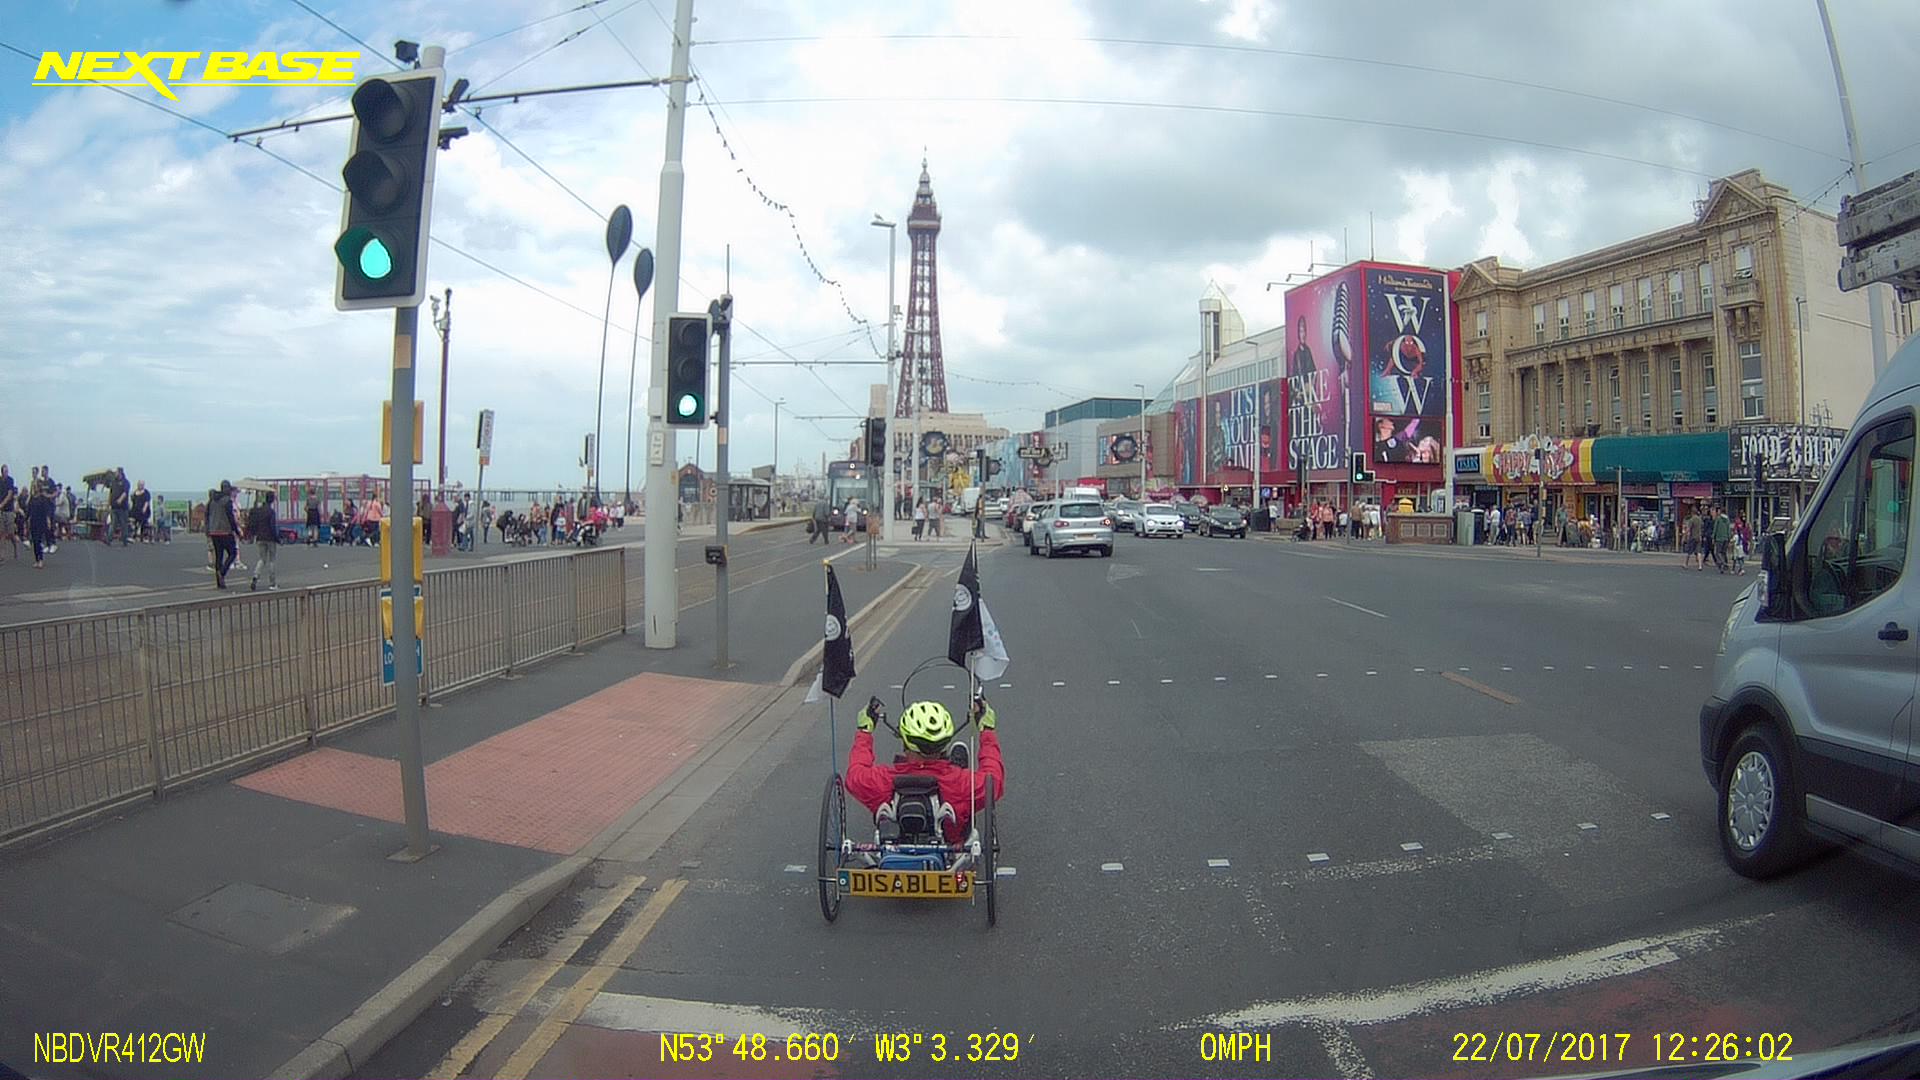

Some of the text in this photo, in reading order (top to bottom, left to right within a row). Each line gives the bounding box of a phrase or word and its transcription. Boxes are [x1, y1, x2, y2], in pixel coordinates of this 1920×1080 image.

[1287, 368, 1331, 407] TAKE
[1287, 404, 1324, 439] THE
[1288, 433, 1339, 470] STAGE
[1740, 434, 1782, 466] FOOD
[852, 872, 969, 894] DISABLED
